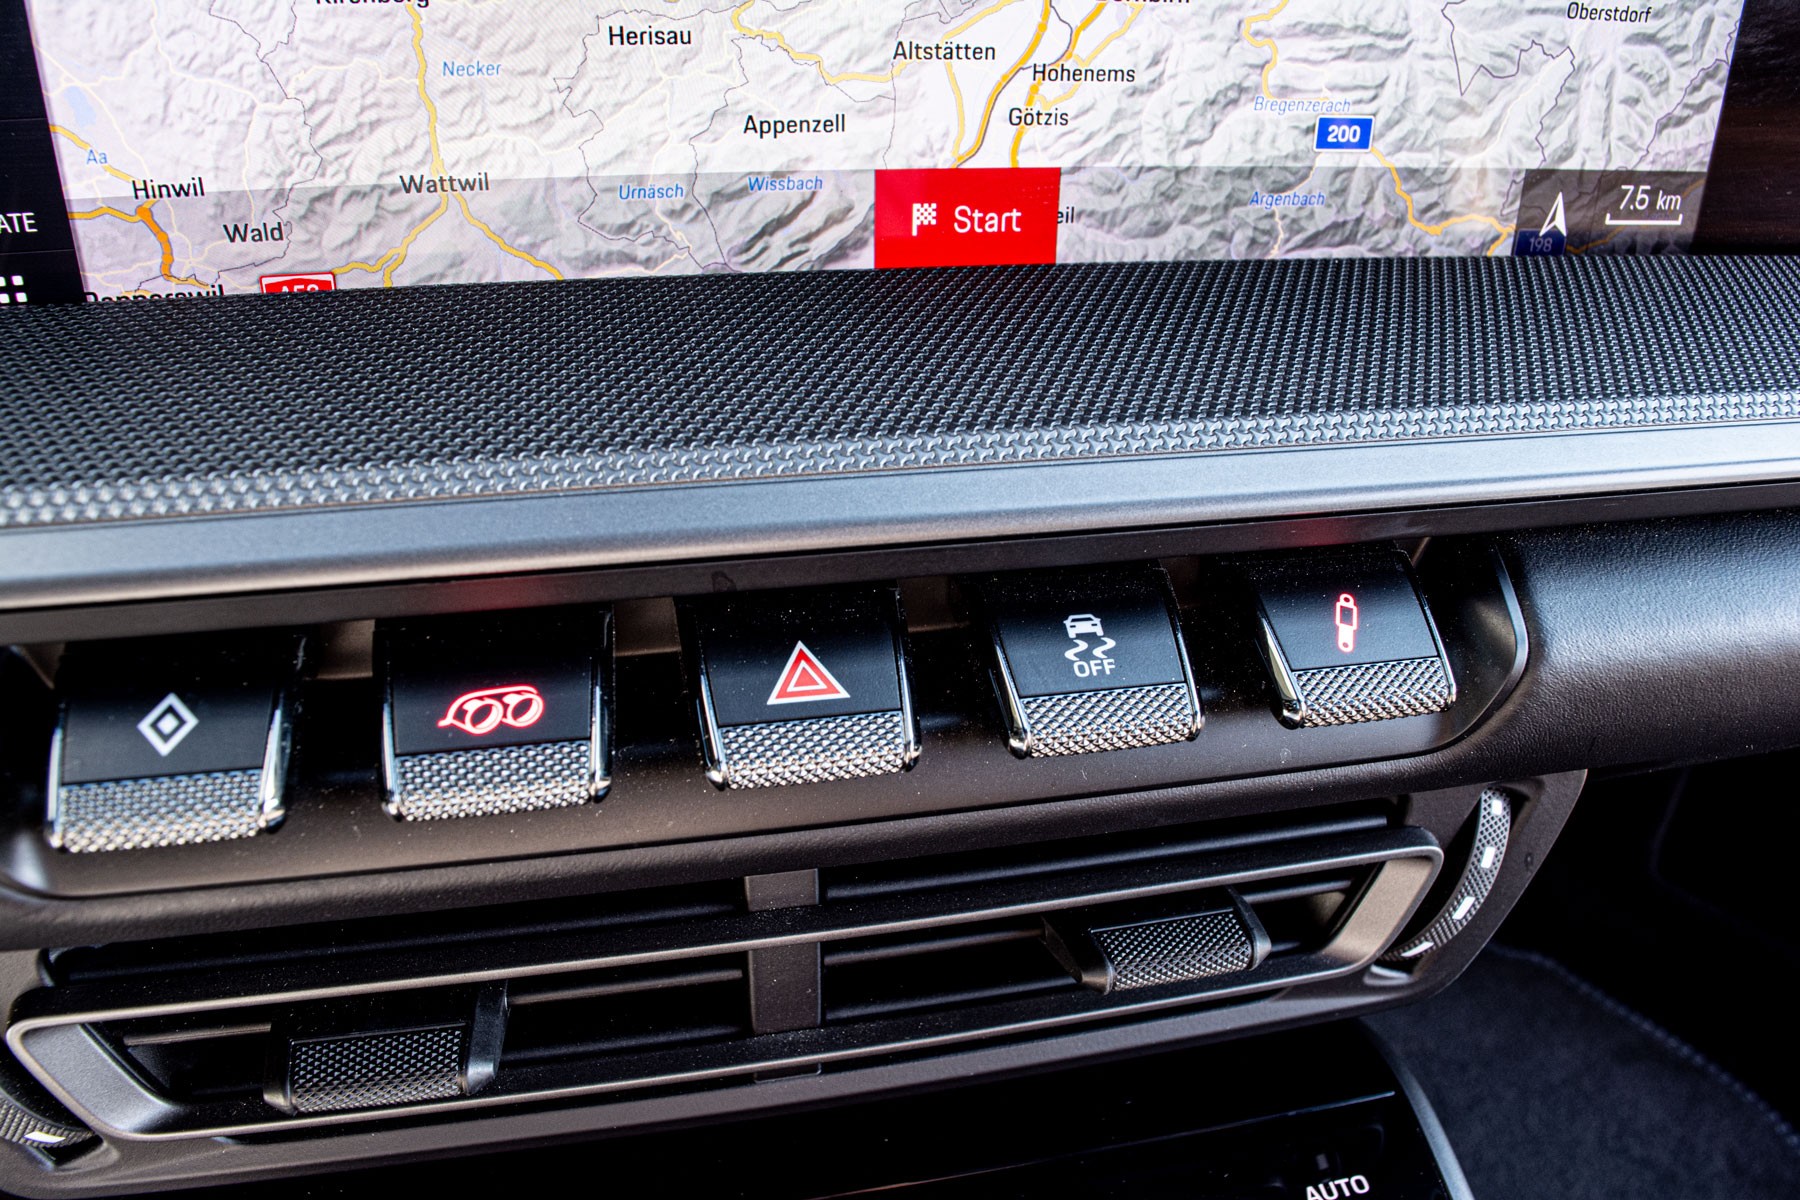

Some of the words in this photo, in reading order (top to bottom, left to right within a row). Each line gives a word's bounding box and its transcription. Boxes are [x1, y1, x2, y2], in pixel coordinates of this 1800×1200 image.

[1566, 2, 1652, 23] Oberstdorf
[609, 25, 692, 46] Herisau
[893, 41, 996, 60] Altstätten
[442, 60, 501, 76] Necker
[1032, 63, 1136, 82] Hohenems
[1253, 96, 1351, 116] Bregenzerach
[743, 114, 846, 139] Appenzell
[1008, 107, 1069, 126] Götzis
[1327, 125, 1361, 142] 200
[86, 149, 108, 165] Aa
[132, 177, 205, 200] Hinwil
[399, 172, 490, 194] Wattwil
[618, 183, 684, 200] Urnäsch
[748, 176, 823, 192] Wissbach
[1249, 191, 1325, 208] Argenbach
[1619, 185, 1651, 211] 7.5
[1656, 190, 1682, 211] km
[953, 205, 1022, 233] Start
[223, 221, 286, 243] Wald
[1529, 236, 1553, 253] 198
[1073, 658, 1116, 678] OFF
[1306, 1174, 1370, 1200] AUTO
